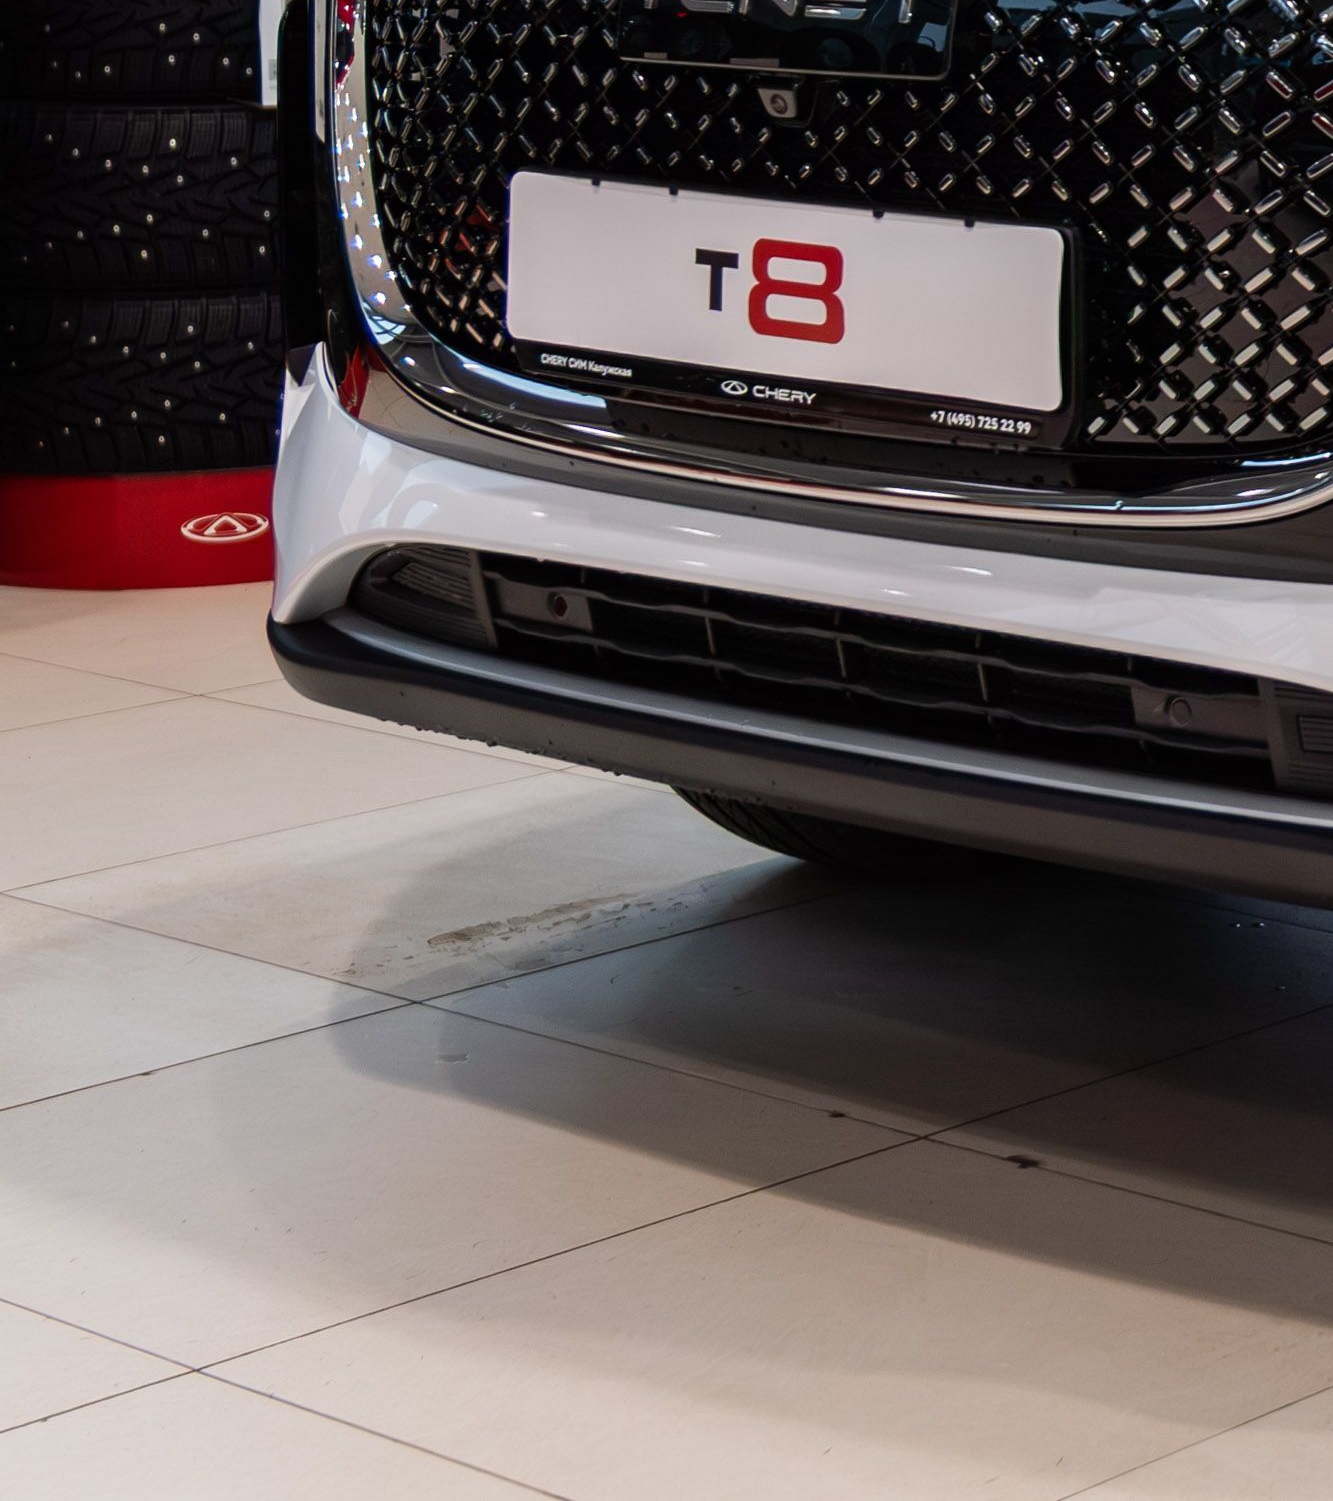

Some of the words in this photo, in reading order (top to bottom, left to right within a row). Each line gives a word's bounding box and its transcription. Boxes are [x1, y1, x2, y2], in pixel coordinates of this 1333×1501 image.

[695, 238, 845, 344] T8
[541, 353, 568, 367] CHERY
[588, 360, 633, 377] Калужская
[752, 384, 816, 406] CHERY
[930, 410, 945, 423] +7
[946, 411, 976, 429] (495)
[977, 415, 998, 430] 725
[1000, 418, 1015, 432] 22
[1016, 420, 1032, 435] 99
